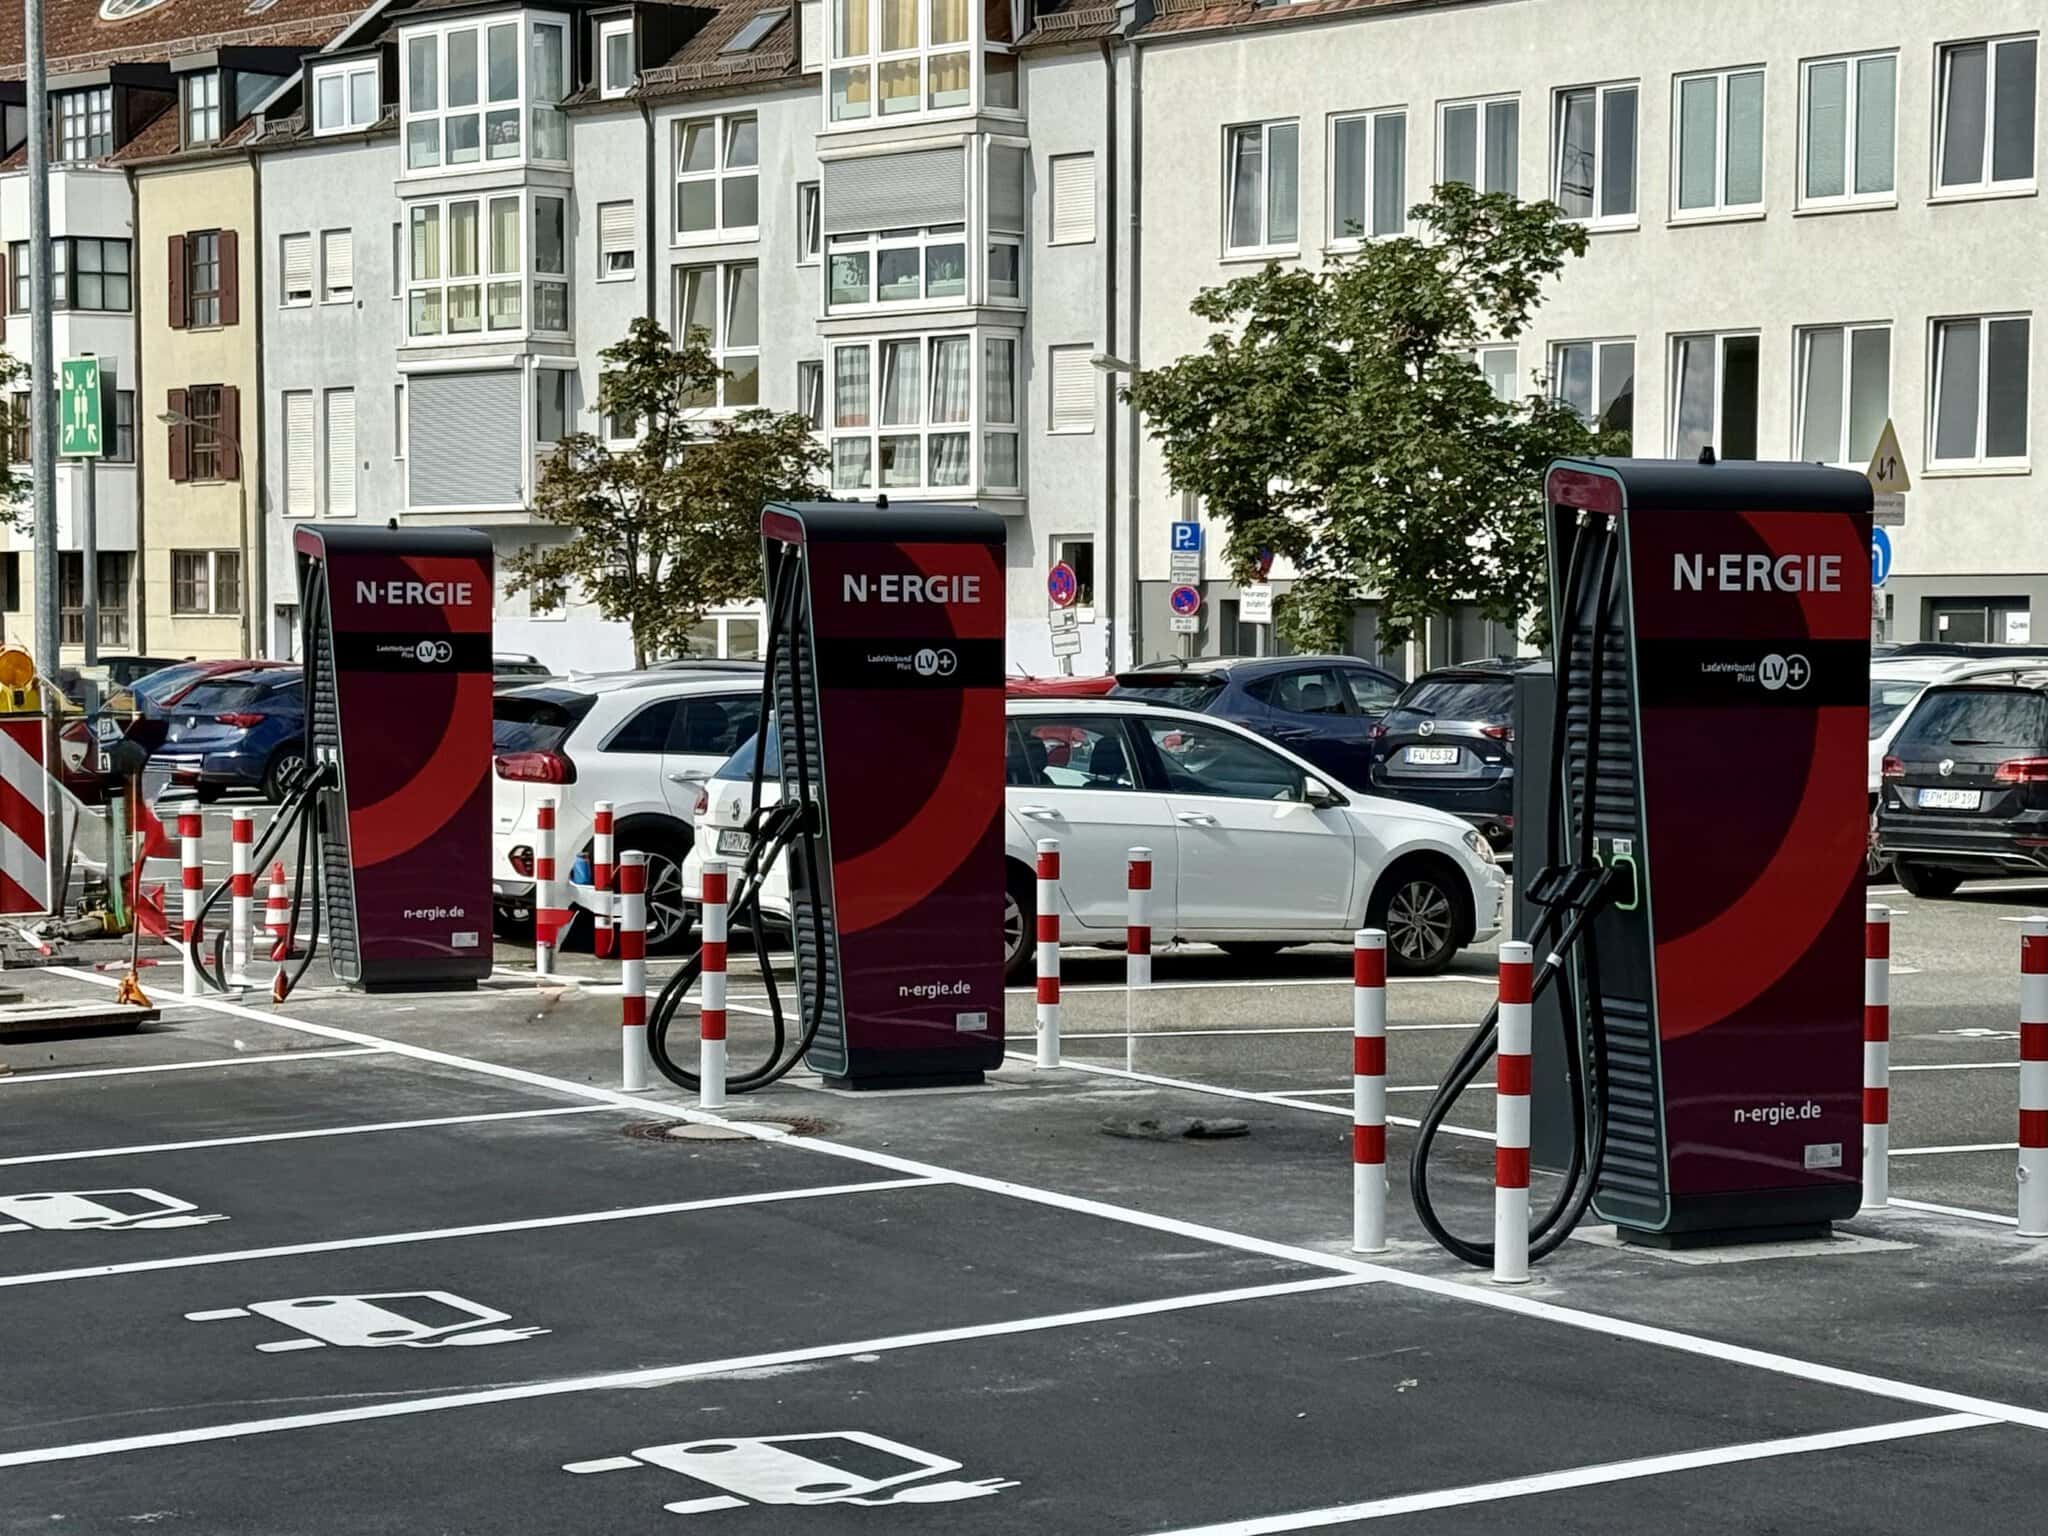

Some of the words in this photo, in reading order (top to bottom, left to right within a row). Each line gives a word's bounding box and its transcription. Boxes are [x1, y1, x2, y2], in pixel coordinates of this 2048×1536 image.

[1175, 525, 1192, 548] P
[1737, 673, 1756, 683] Plus
[403, 905, 465, 921] n-ergie.de
[899, 980, 972, 999] n-ergie.de
[1733, 1100, 1822, 1126] n-ergie.de
